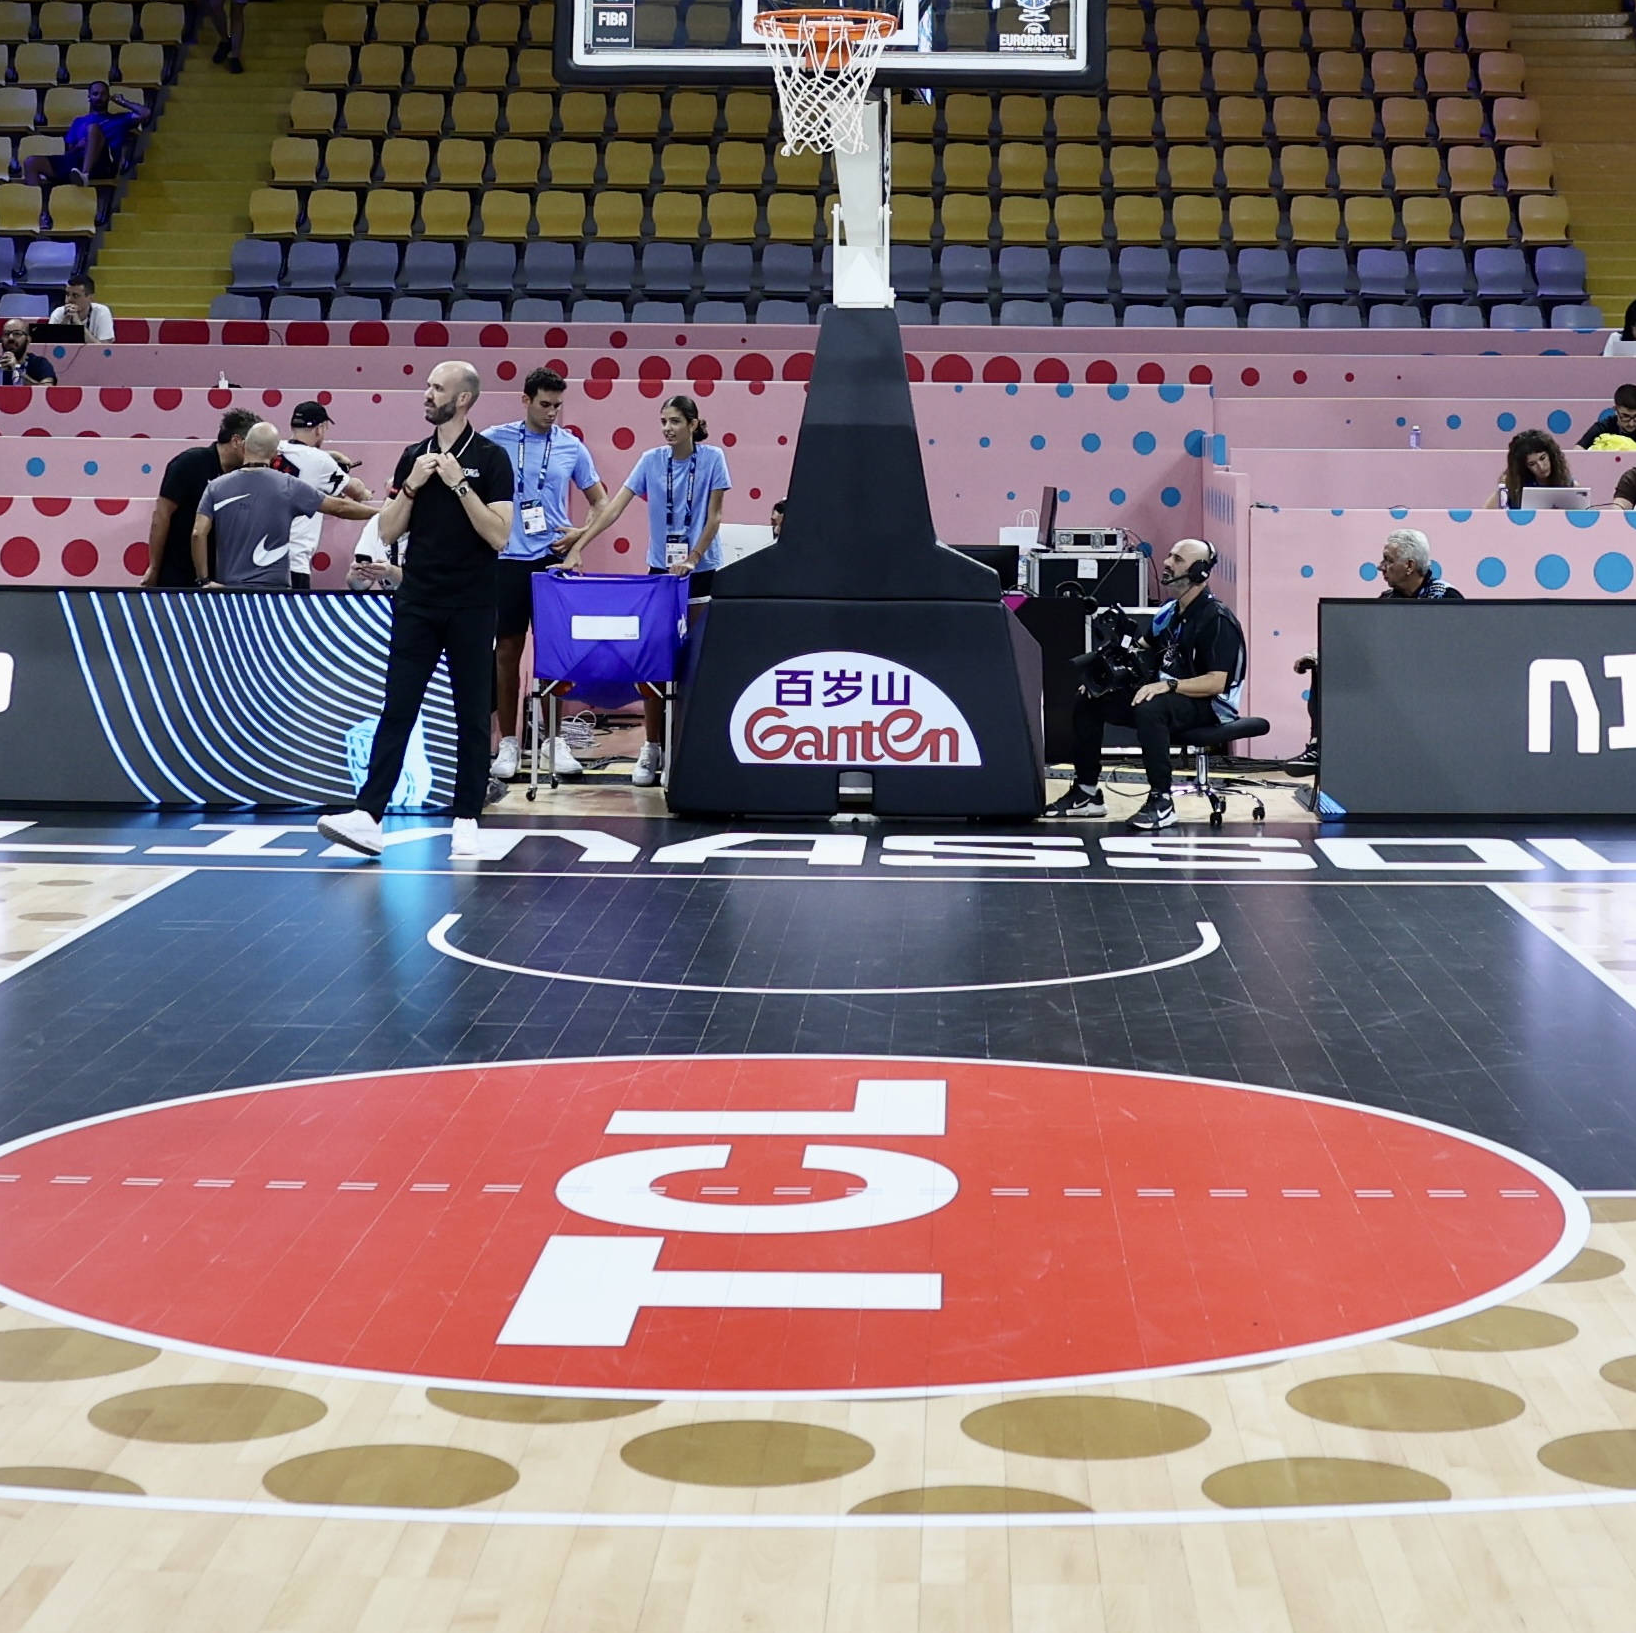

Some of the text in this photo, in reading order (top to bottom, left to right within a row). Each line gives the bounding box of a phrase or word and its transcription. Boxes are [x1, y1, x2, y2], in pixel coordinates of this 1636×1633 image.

[598, 11, 628, 27] FIBA
[999, 34, 1069, 48] EUROBASKET
[774, 669, 911, 708] 百岁山
[495, 1078, 959, 1347] TCL
